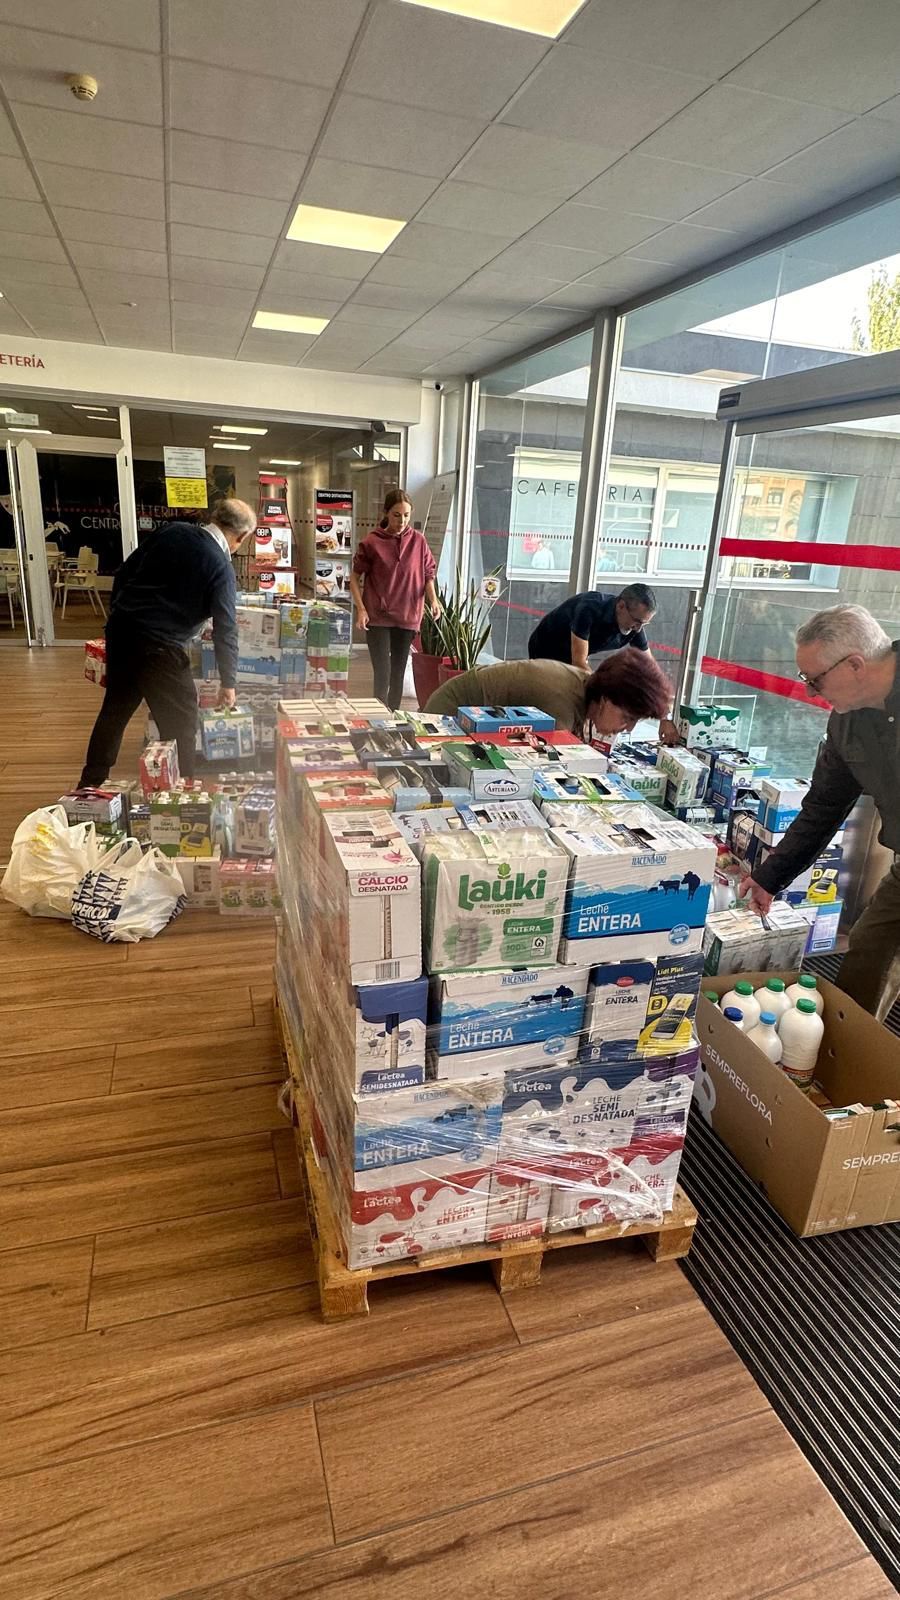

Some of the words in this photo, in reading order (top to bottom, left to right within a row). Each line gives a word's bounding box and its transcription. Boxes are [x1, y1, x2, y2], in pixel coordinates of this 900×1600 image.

[517, 479, 643, 501] CAFERIA
[358, 875, 408, 886] CALCIO
[358, 884, 408, 893] DESNATADA
[580, 904, 609, 916] Leche
[507, 925, 541, 933] ENTERA
[577, 913, 642, 933] ENTERA
[605, 995, 639, 1005] ENTERA
[448, 1027, 514, 1050] ENTERA
[361, 1078, 419, 1091] SEMIDESNATADA
[705, 1044, 774, 1126] SEMPREFLORA
[592, 1094, 622, 1104] LECHE
[593, 1103, 619, 1113] SEMI
[572, 1109, 635, 1124] DESNATADA
